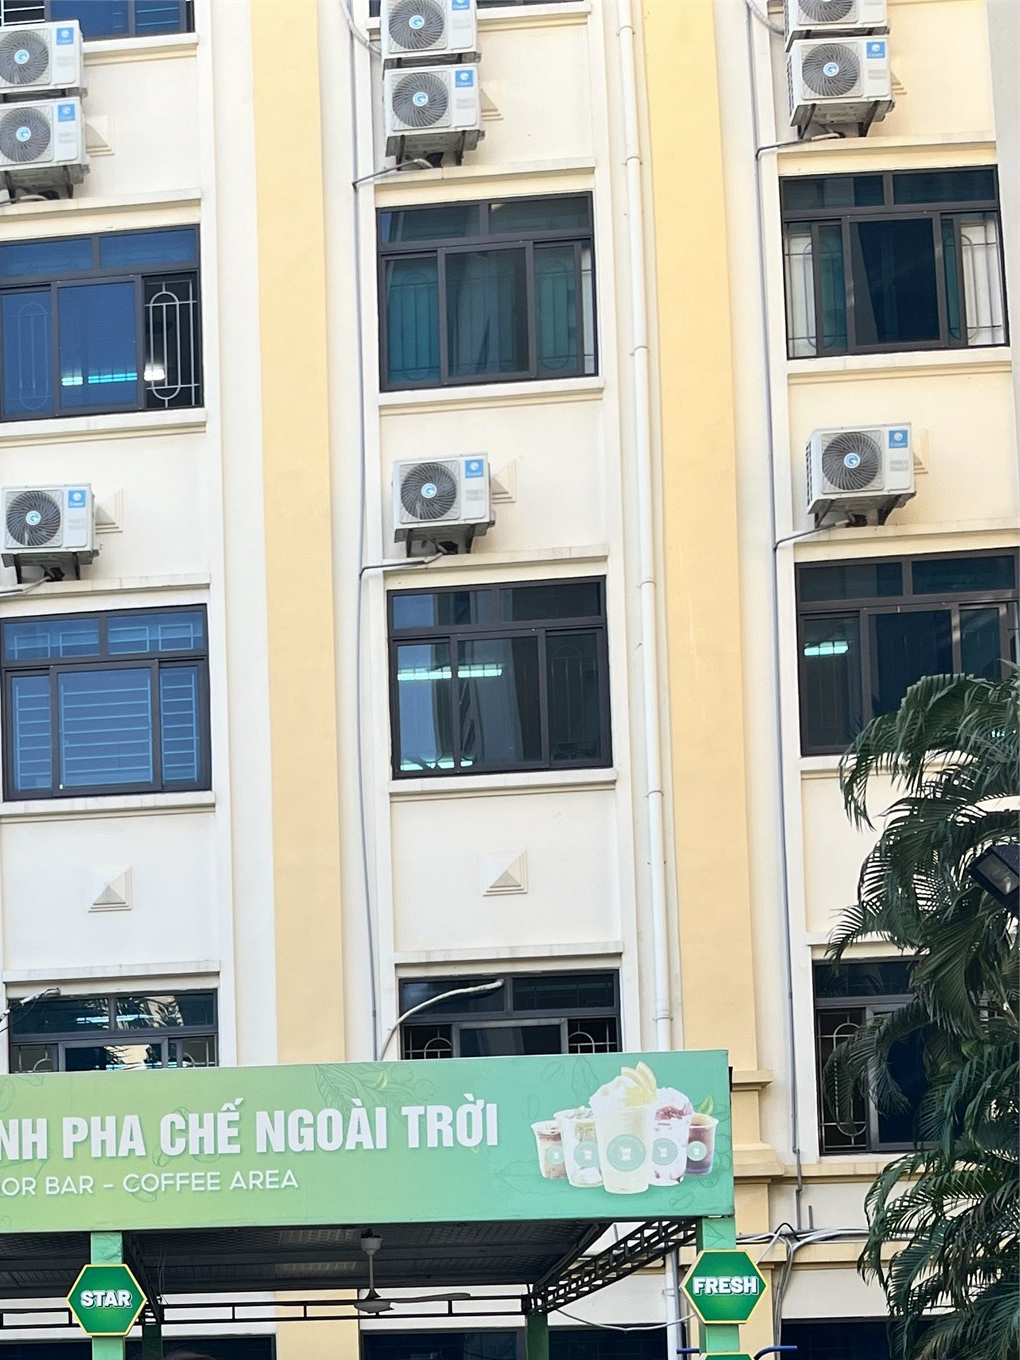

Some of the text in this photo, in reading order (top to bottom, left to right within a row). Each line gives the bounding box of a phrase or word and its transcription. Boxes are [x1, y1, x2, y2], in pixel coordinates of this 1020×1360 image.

[61, 1113, 146, 1160] PHA
[159, 1097, 244, 1156] CHẾ
[255, 1098, 387, 1153] NGOÀI
[400, 1092, 499, 1150] TRỜI
[45, 1174, 94, 1196] BAR
[123, 1171, 222, 1193] COFFEE
[229, 1168, 299, 1191] AREA
[693, 1276, 759, 1295] FRESH
[80, 1290, 133, 1308] STAR
